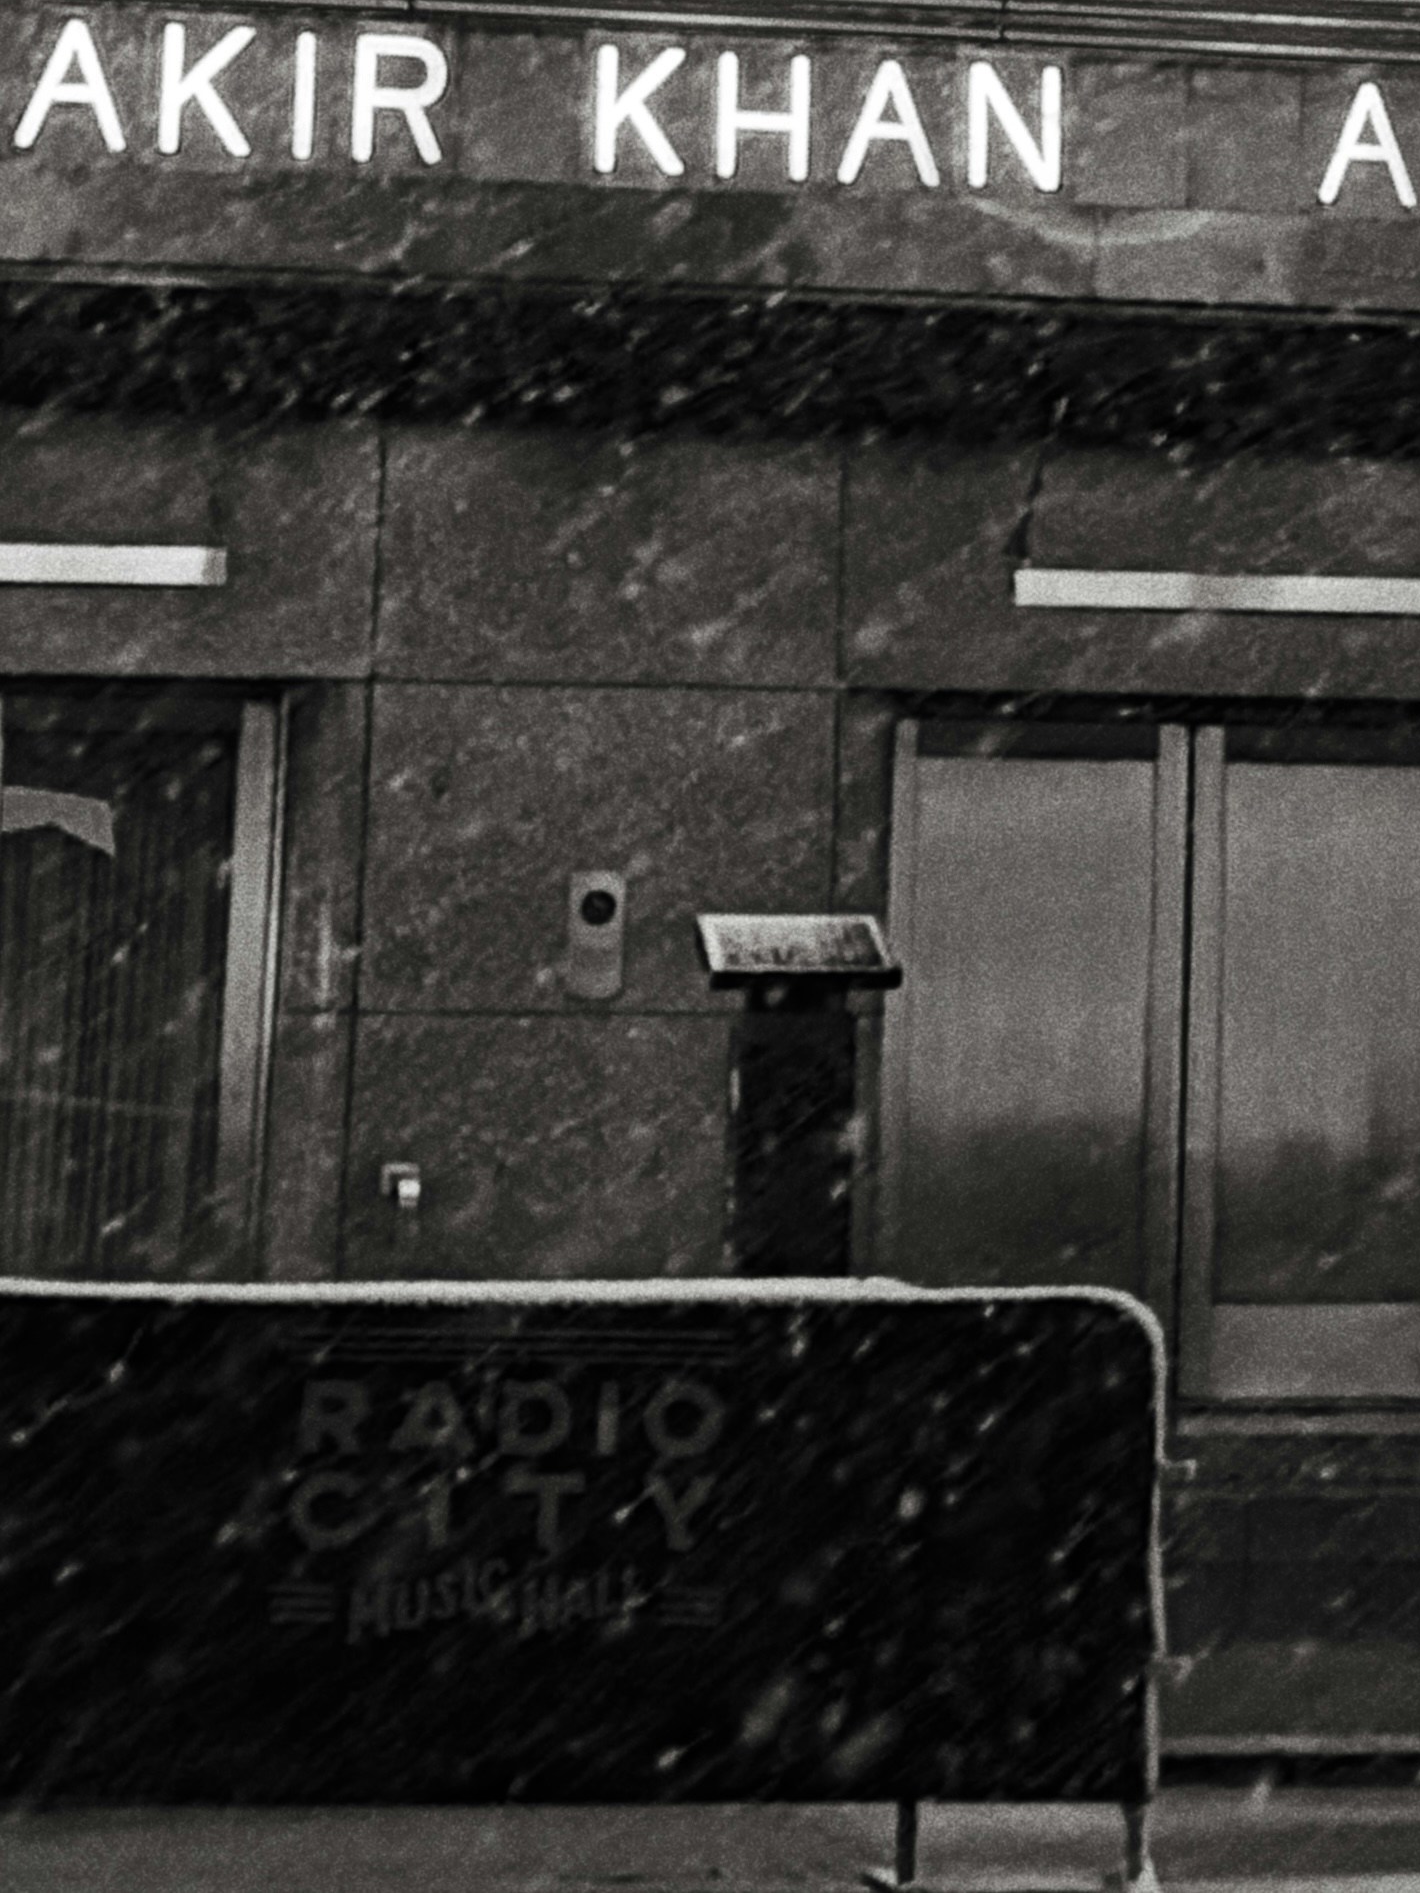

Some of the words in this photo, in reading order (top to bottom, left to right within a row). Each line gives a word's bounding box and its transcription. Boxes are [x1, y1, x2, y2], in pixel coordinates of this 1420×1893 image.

[13, 18, 442, 164] AKIR
[594, 42, 1062, 192] KHAN
[297, 1379, 724, 1457] RADIO
[289, 1471, 717, 1551] CITY
